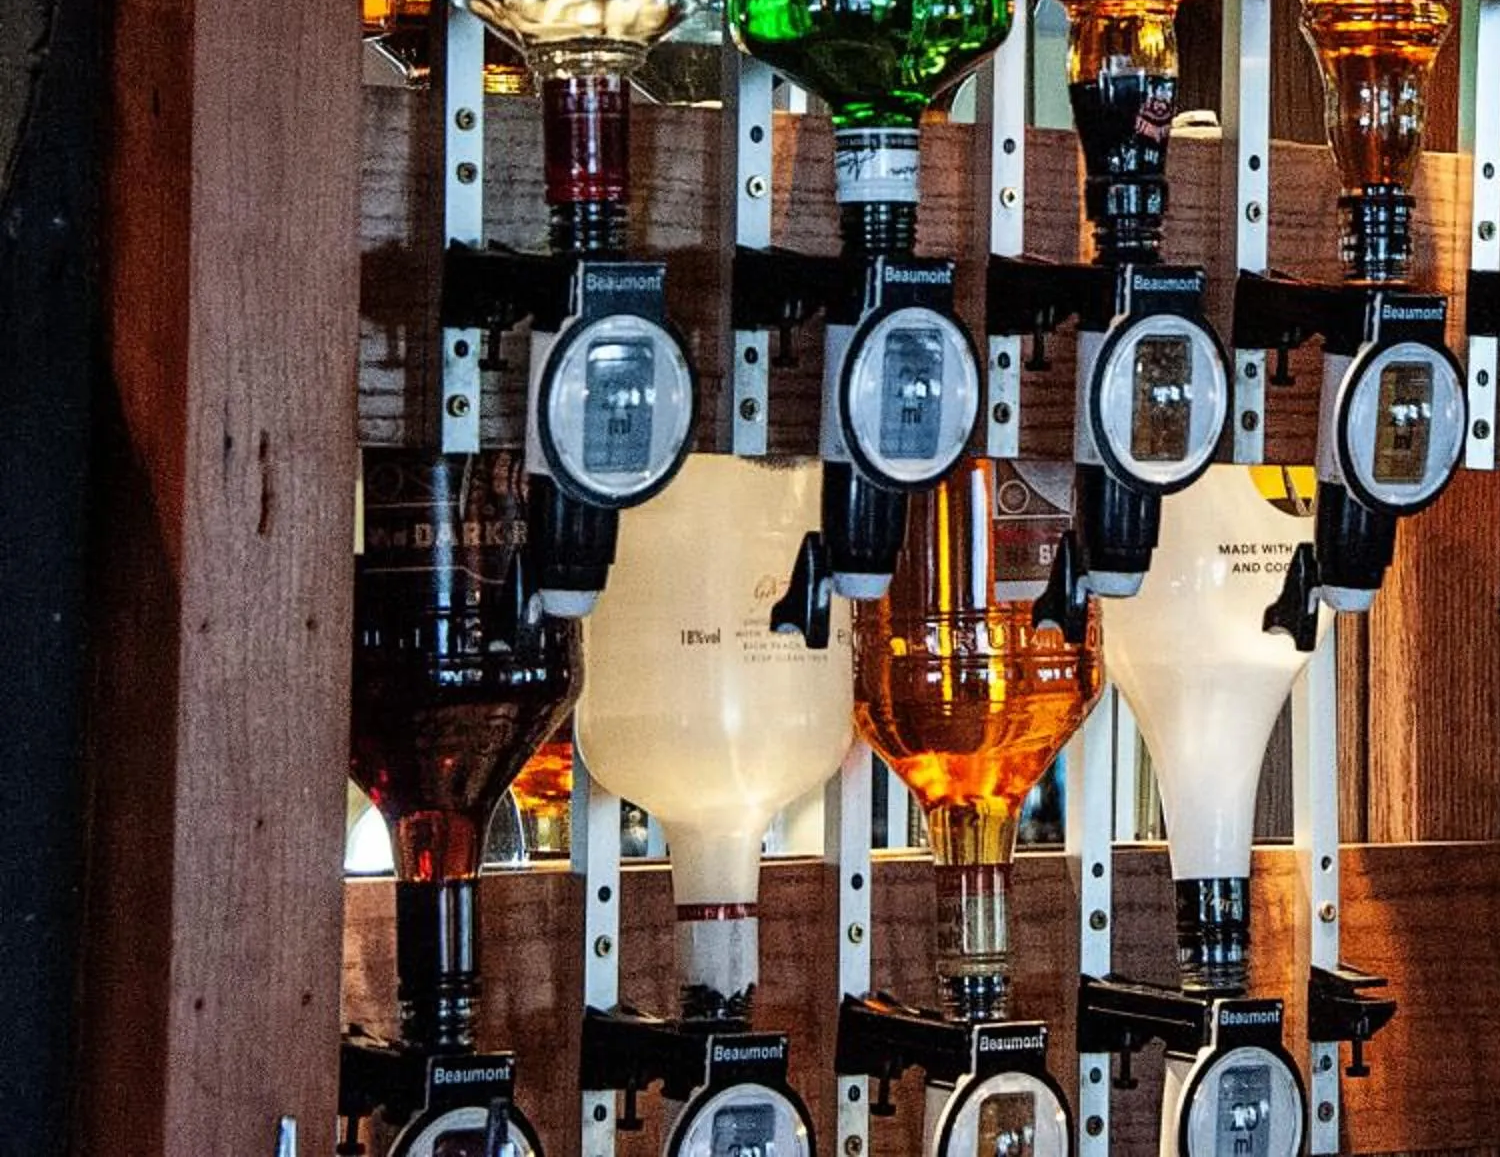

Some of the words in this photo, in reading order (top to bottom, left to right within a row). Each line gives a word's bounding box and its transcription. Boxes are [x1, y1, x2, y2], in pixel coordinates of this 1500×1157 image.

[585, 273, 662, 291] Beaumont
[884, 266, 952, 284] Beaumont
[1133, 275, 1201, 292] Beaumont
[1382, 304, 1444, 321] Beaumont
[1218, 544, 1258, 556] MADE
[1261, 543, 1294, 555] WITH
[1231, 561, 1261, 573] AND
[1219, 1010, 1280, 1026] Beaumont
[979, 1034, 1044, 1051] Beaumont
[713, 1044, 784, 1061] Beaumont
[434, 1067, 511, 1084] Beaumont
